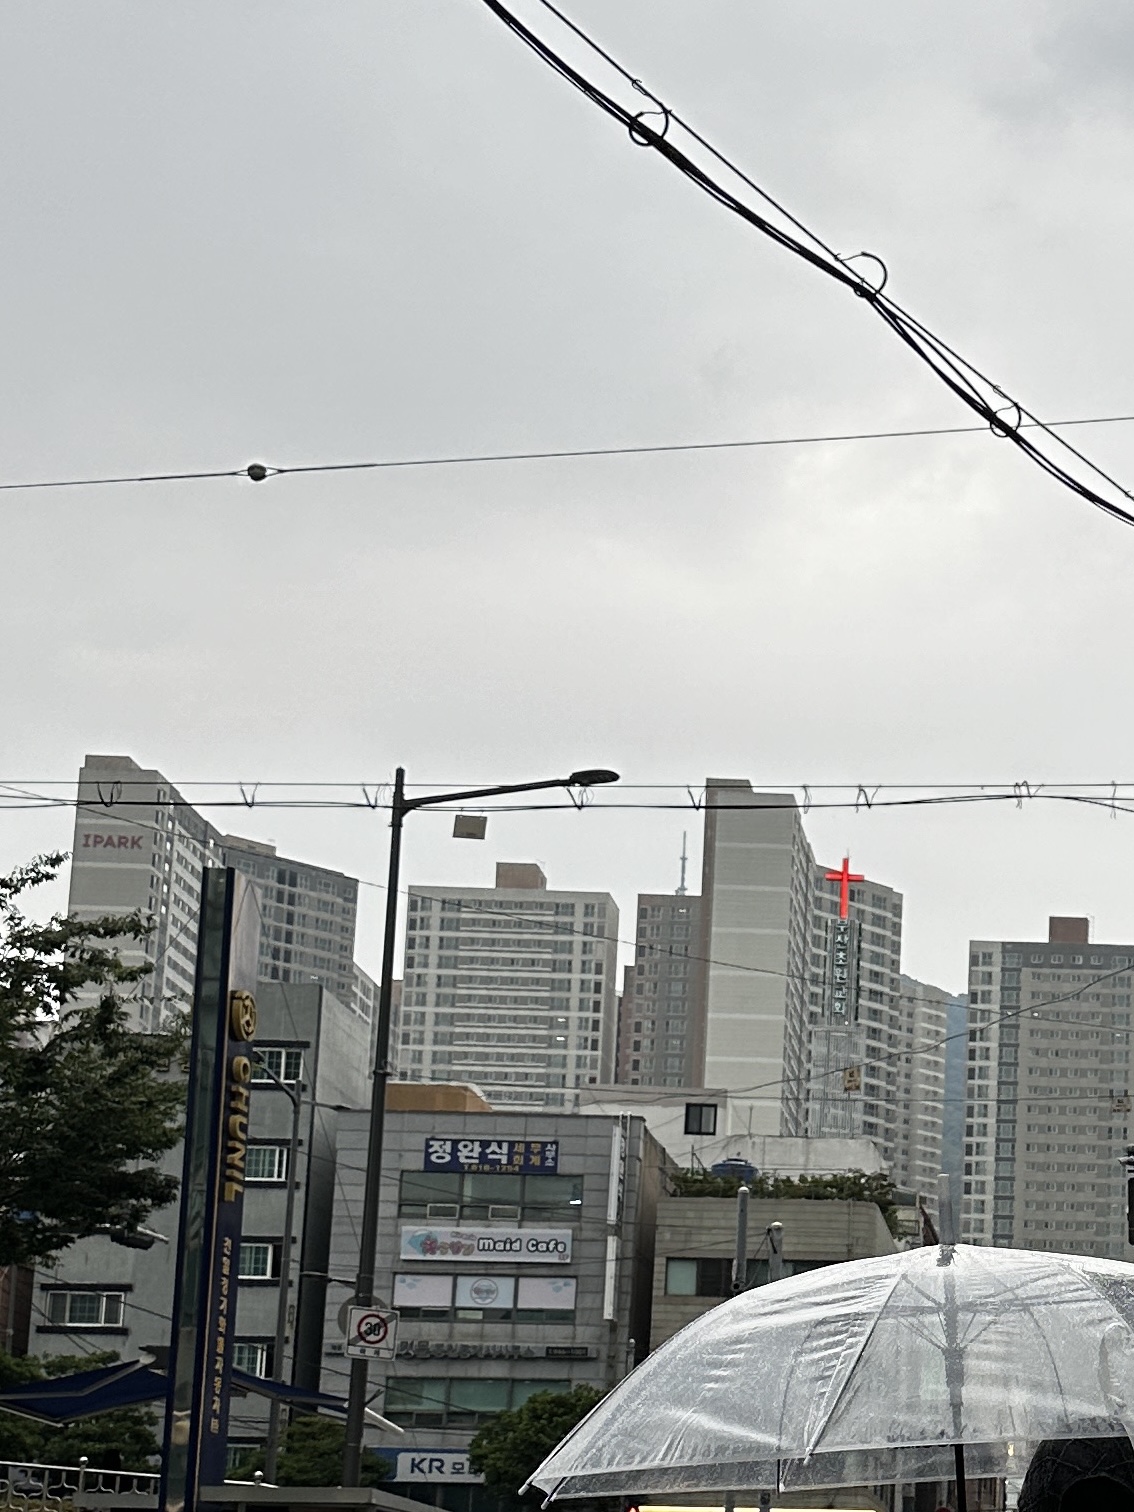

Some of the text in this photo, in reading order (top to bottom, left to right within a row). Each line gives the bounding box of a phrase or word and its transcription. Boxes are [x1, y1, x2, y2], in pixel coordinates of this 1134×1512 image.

[83, 833, 143, 849] IPARK
[428, 1140, 509, 1164] 정완식
[477, 1237, 522, 1252] Maid
[526, 1238, 567, 1254] Cafe
[365, 1321, 381, 1336] 30
[410, 1457, 446, 1475] KR
